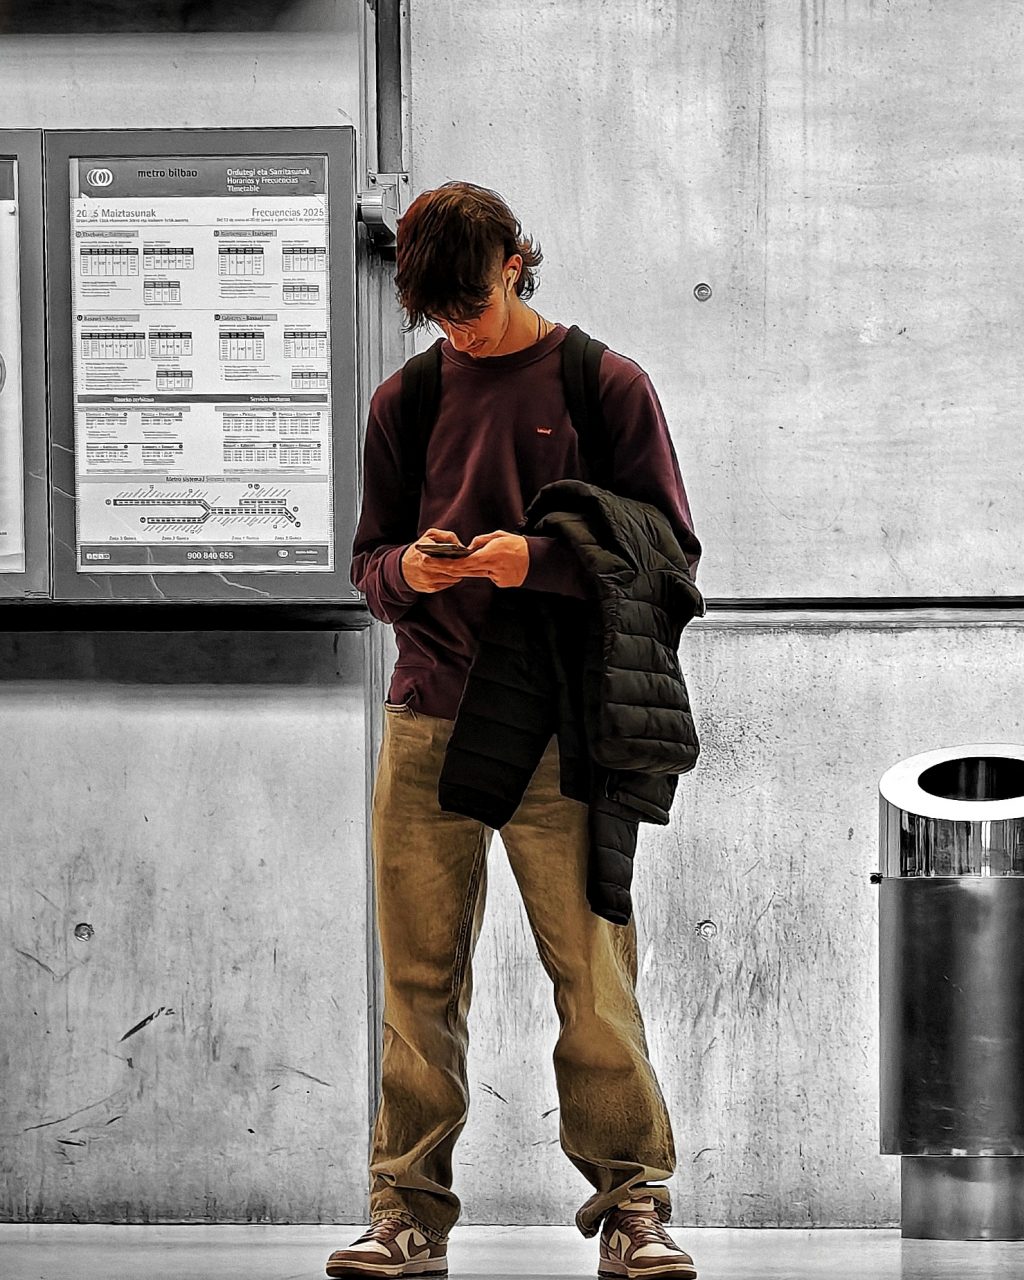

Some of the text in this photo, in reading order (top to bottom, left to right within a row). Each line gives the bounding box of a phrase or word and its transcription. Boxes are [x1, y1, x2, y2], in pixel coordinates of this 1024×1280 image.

[137, 168, 198, 178] metro bilbao
[226, 168, 256, 177] Ordutegi
[257, 168, 268, 176] eta
[76, 208, 157, 218] 205 Maiztasunak
[252, 207, 325, 217] Frecuencias 2025
[187, 551, 234, 560] 900 840 655
